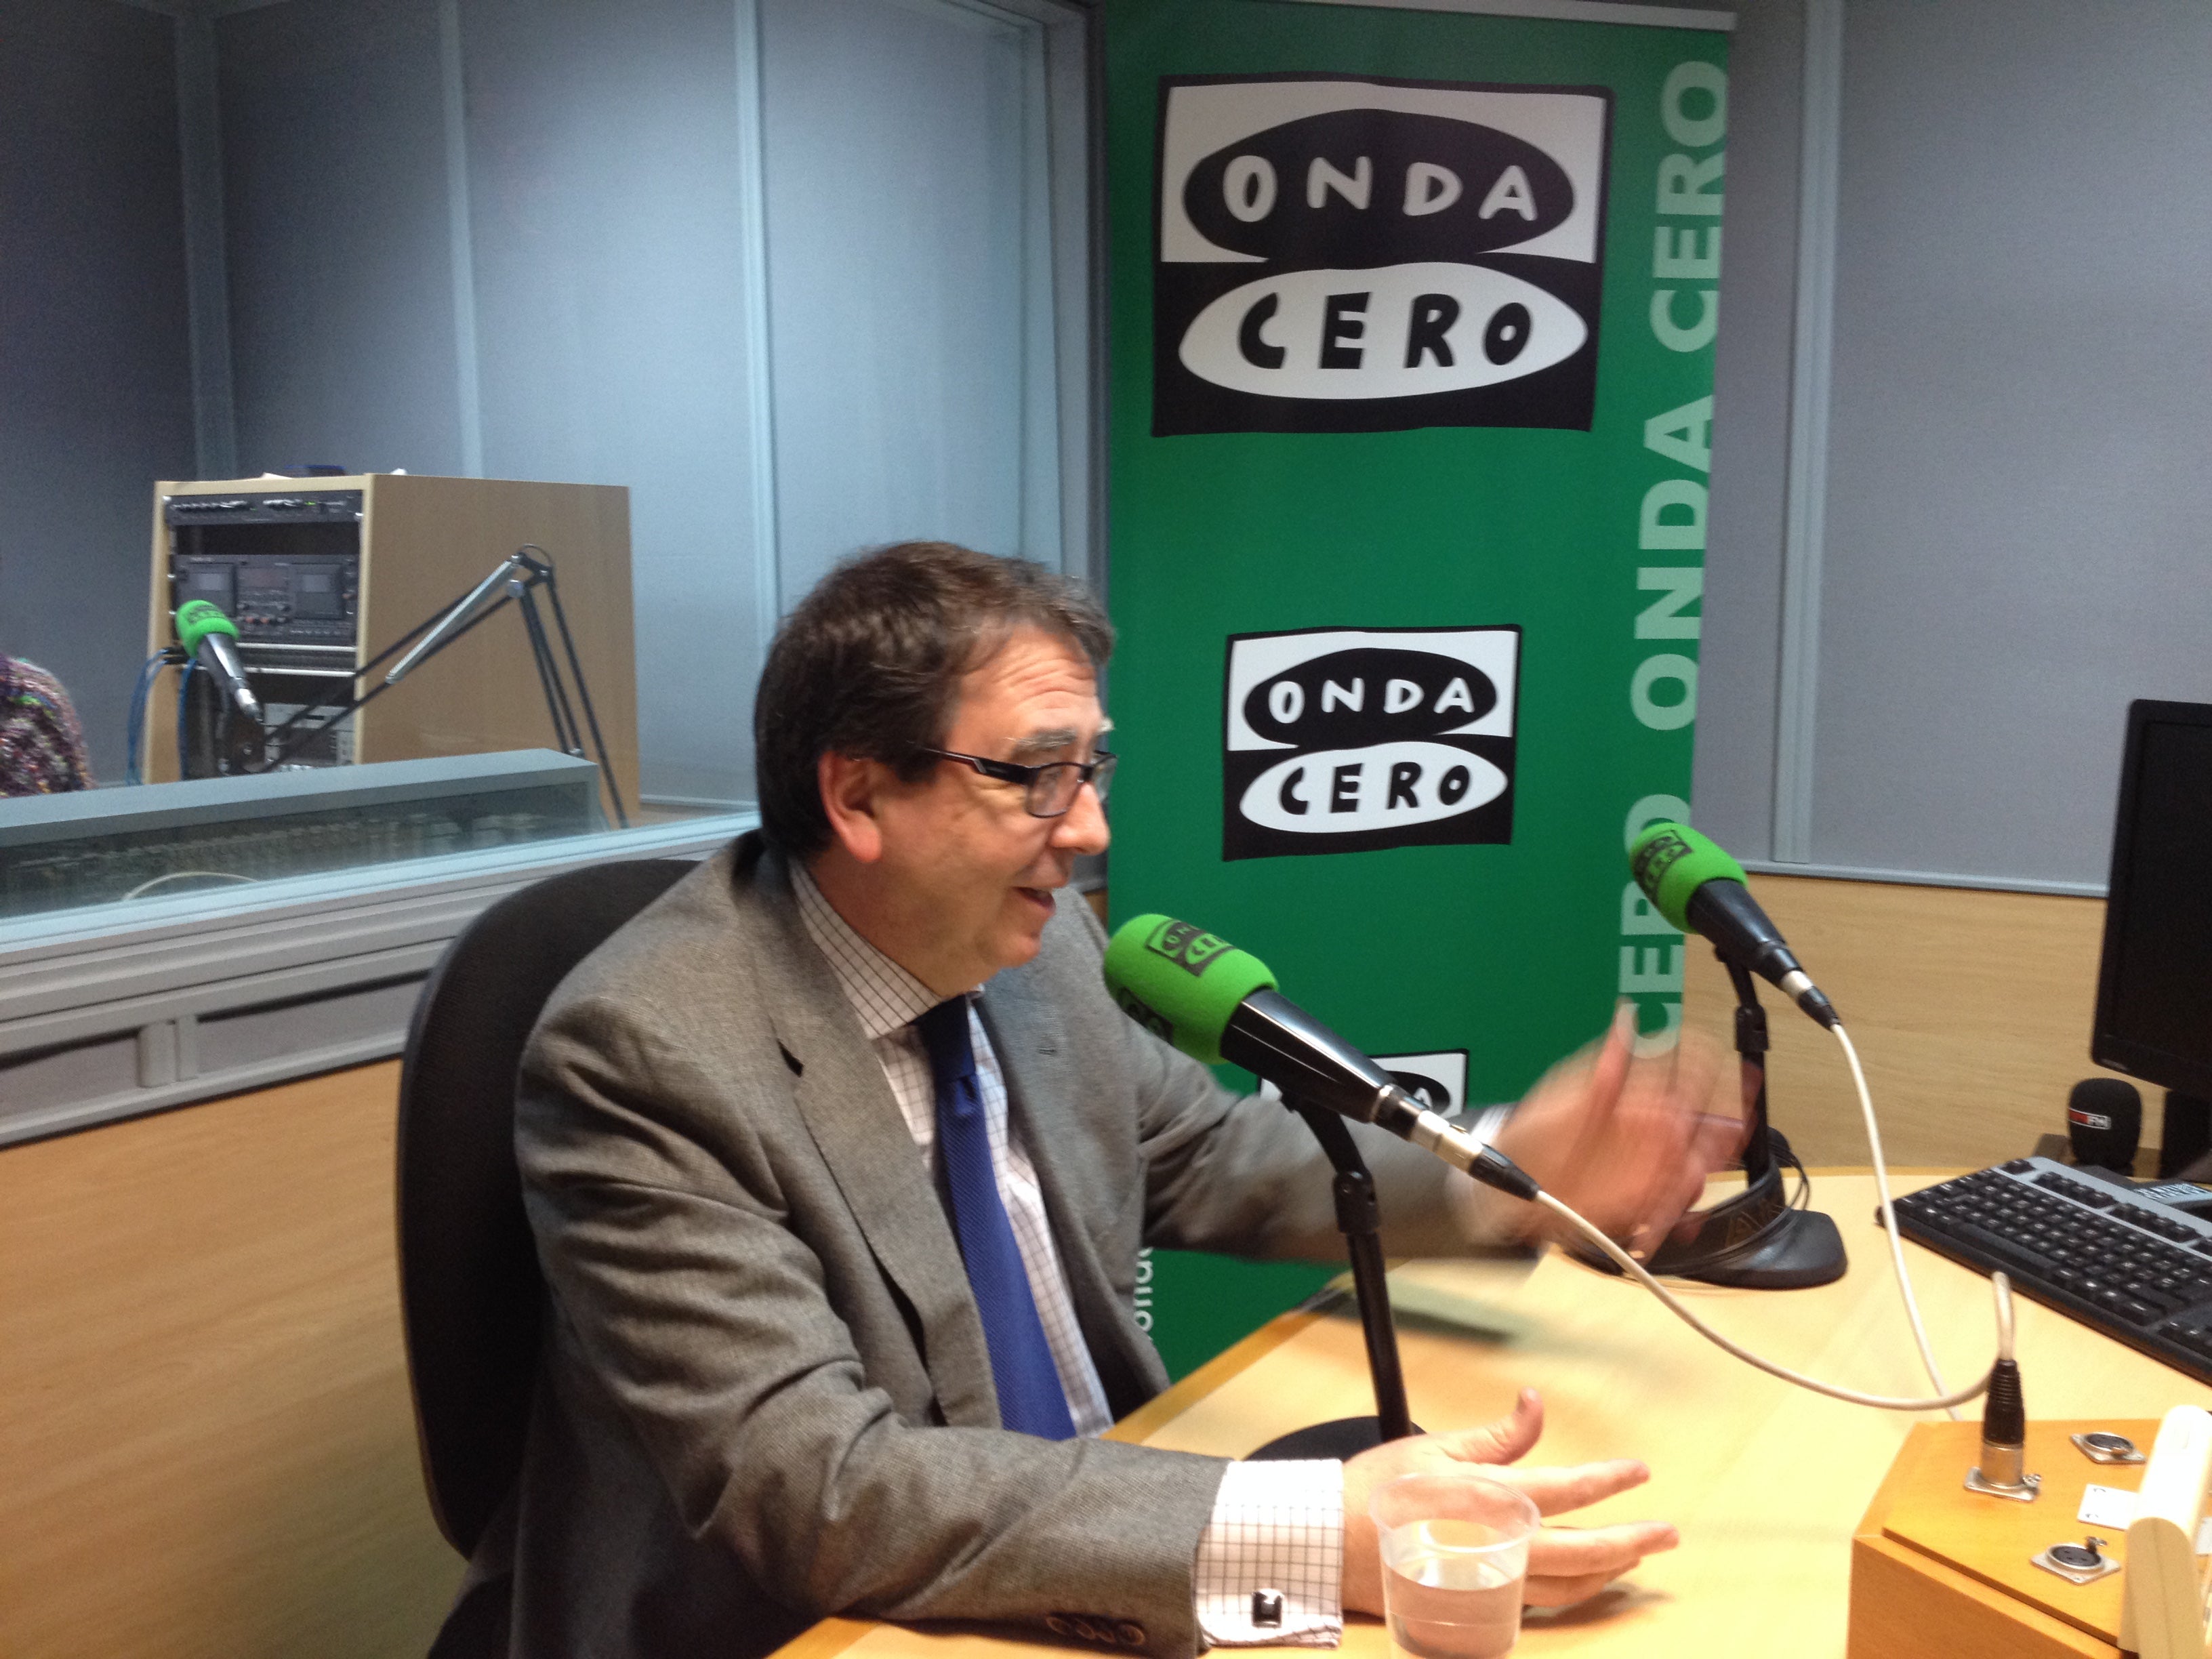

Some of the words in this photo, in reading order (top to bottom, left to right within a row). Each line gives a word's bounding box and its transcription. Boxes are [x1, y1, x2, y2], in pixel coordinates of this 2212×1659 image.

[1223, 155, 1538, 222] ONDA
[1650, 60, 1728, 352] CERO
[1237, 291, 1532, 369] CERO
[1631, 394, 1713, 731] ONDA
[1268, 678, 1475, 724] ONDA
[1279, 762, 1471, 815] CERO
